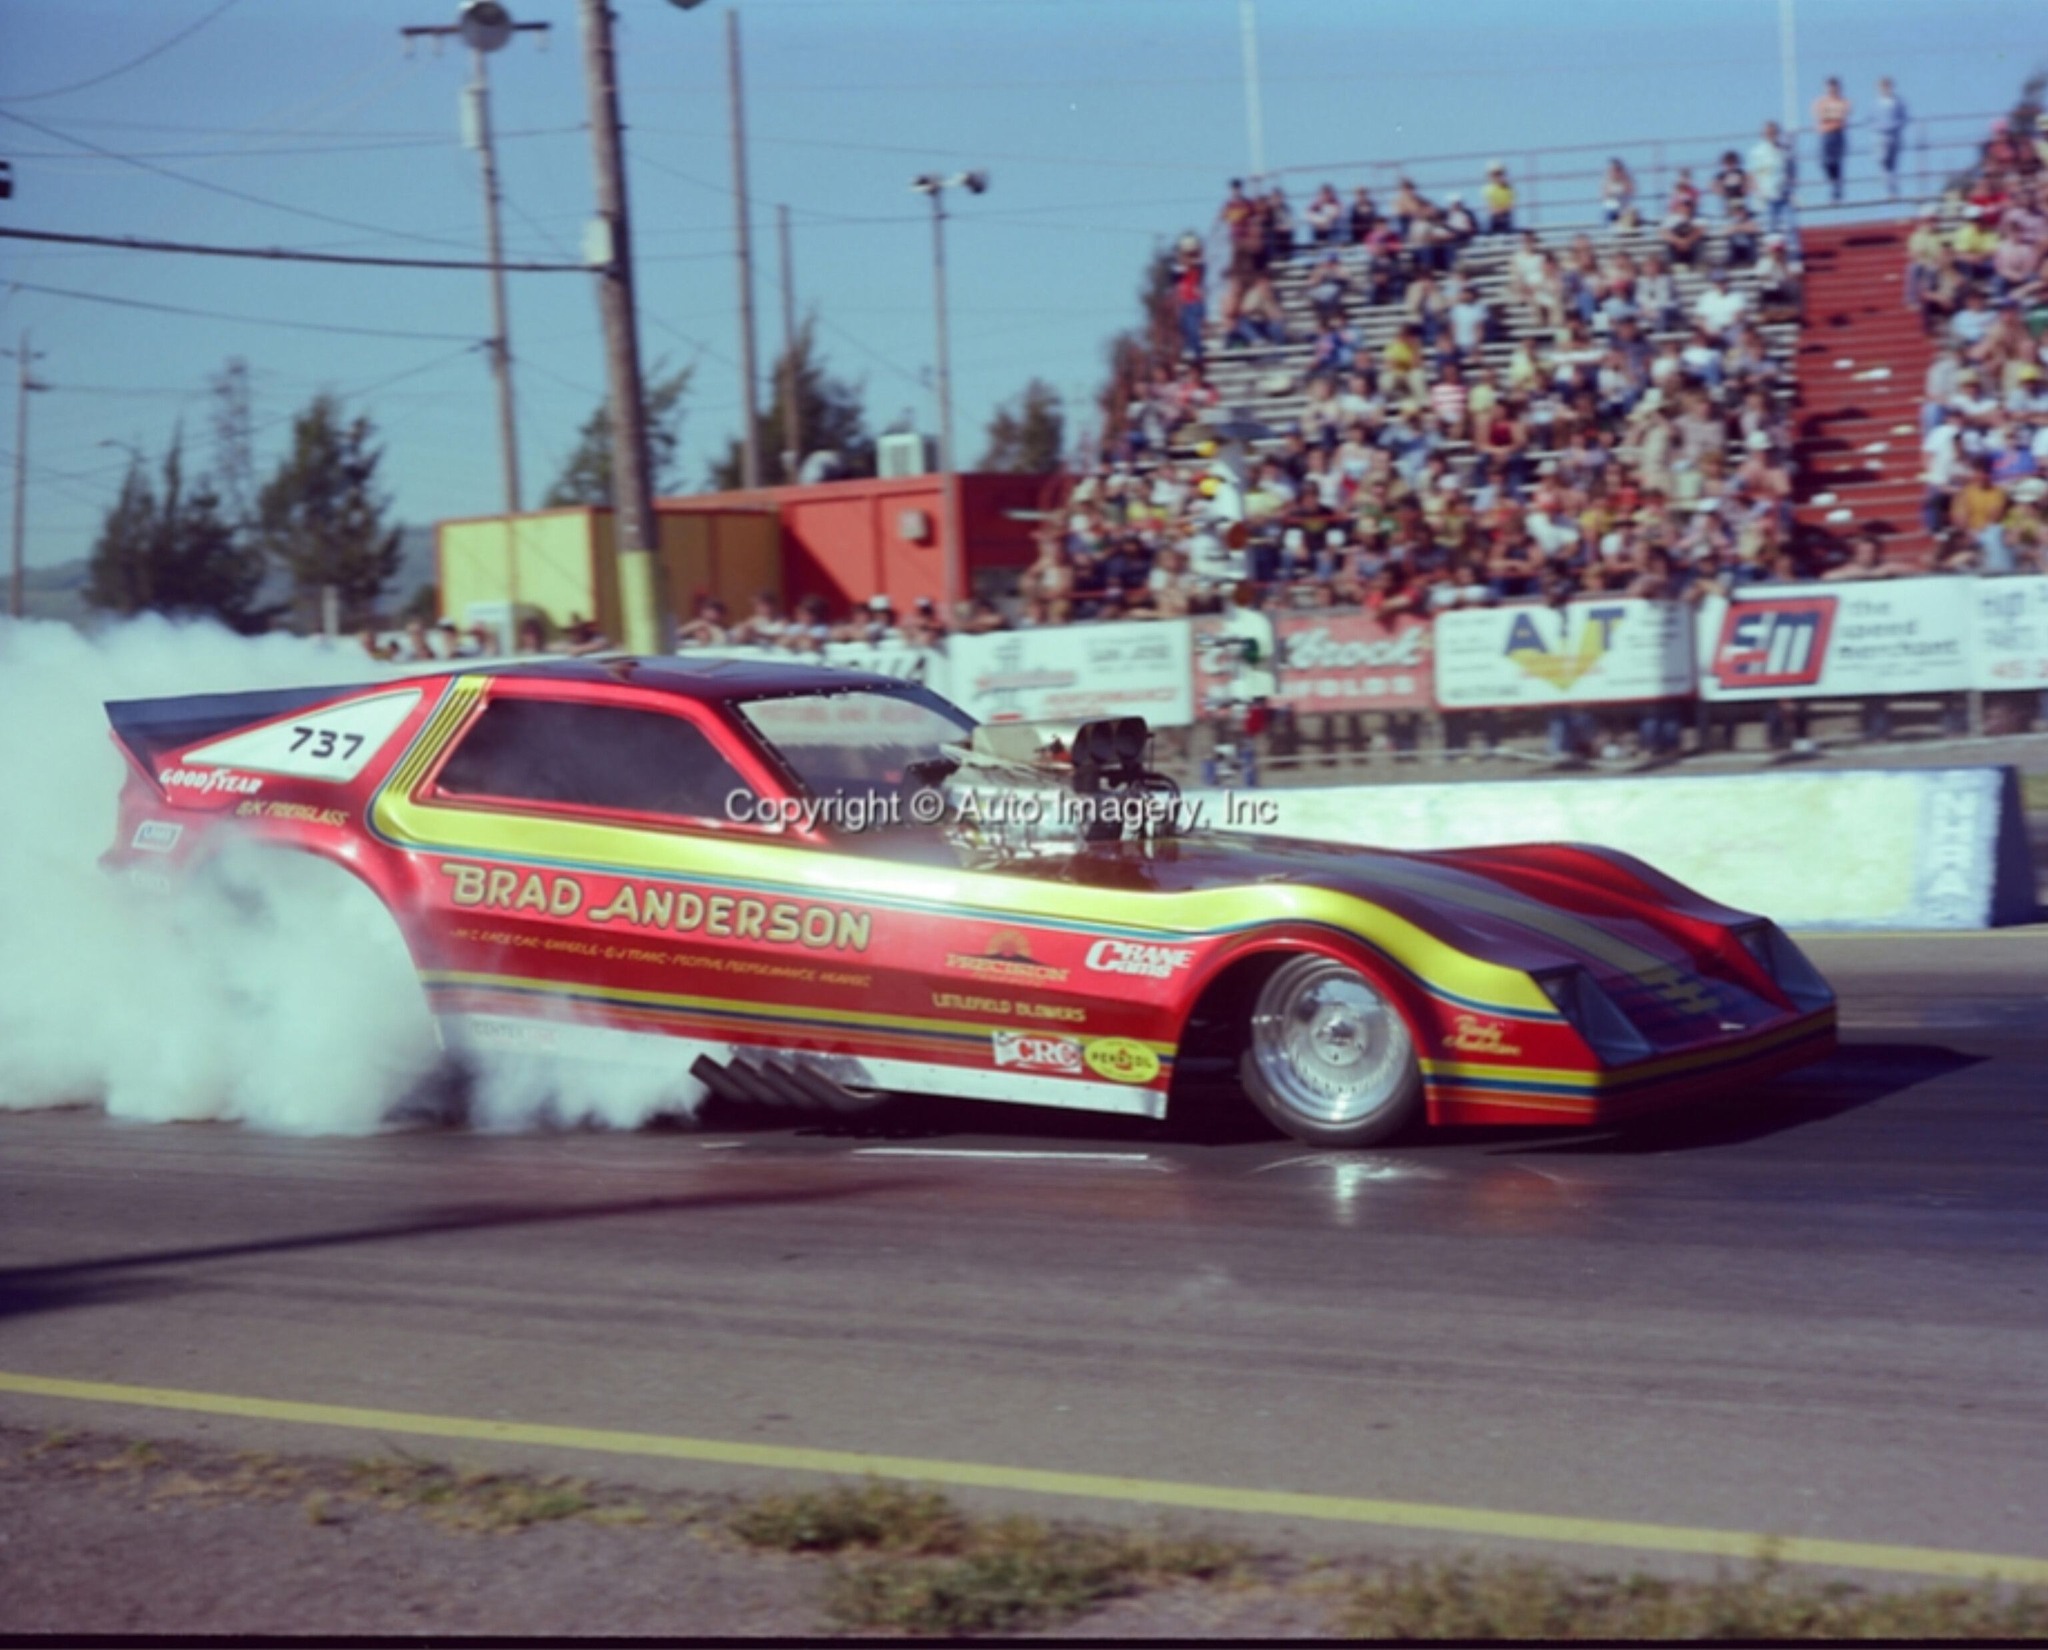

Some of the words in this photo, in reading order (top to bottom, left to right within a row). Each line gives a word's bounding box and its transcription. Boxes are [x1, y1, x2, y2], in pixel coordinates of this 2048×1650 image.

[289, 726, 365, 760] 737
[159, 768, 263, 795] GOODYEAR
[440, 861, 582, 916] BRAD
[587, 884, 872, 951] ANDERSON
[1085, 939, 1196, 972] CRANE
[1015, 1036, 1082, 1067] CRC
